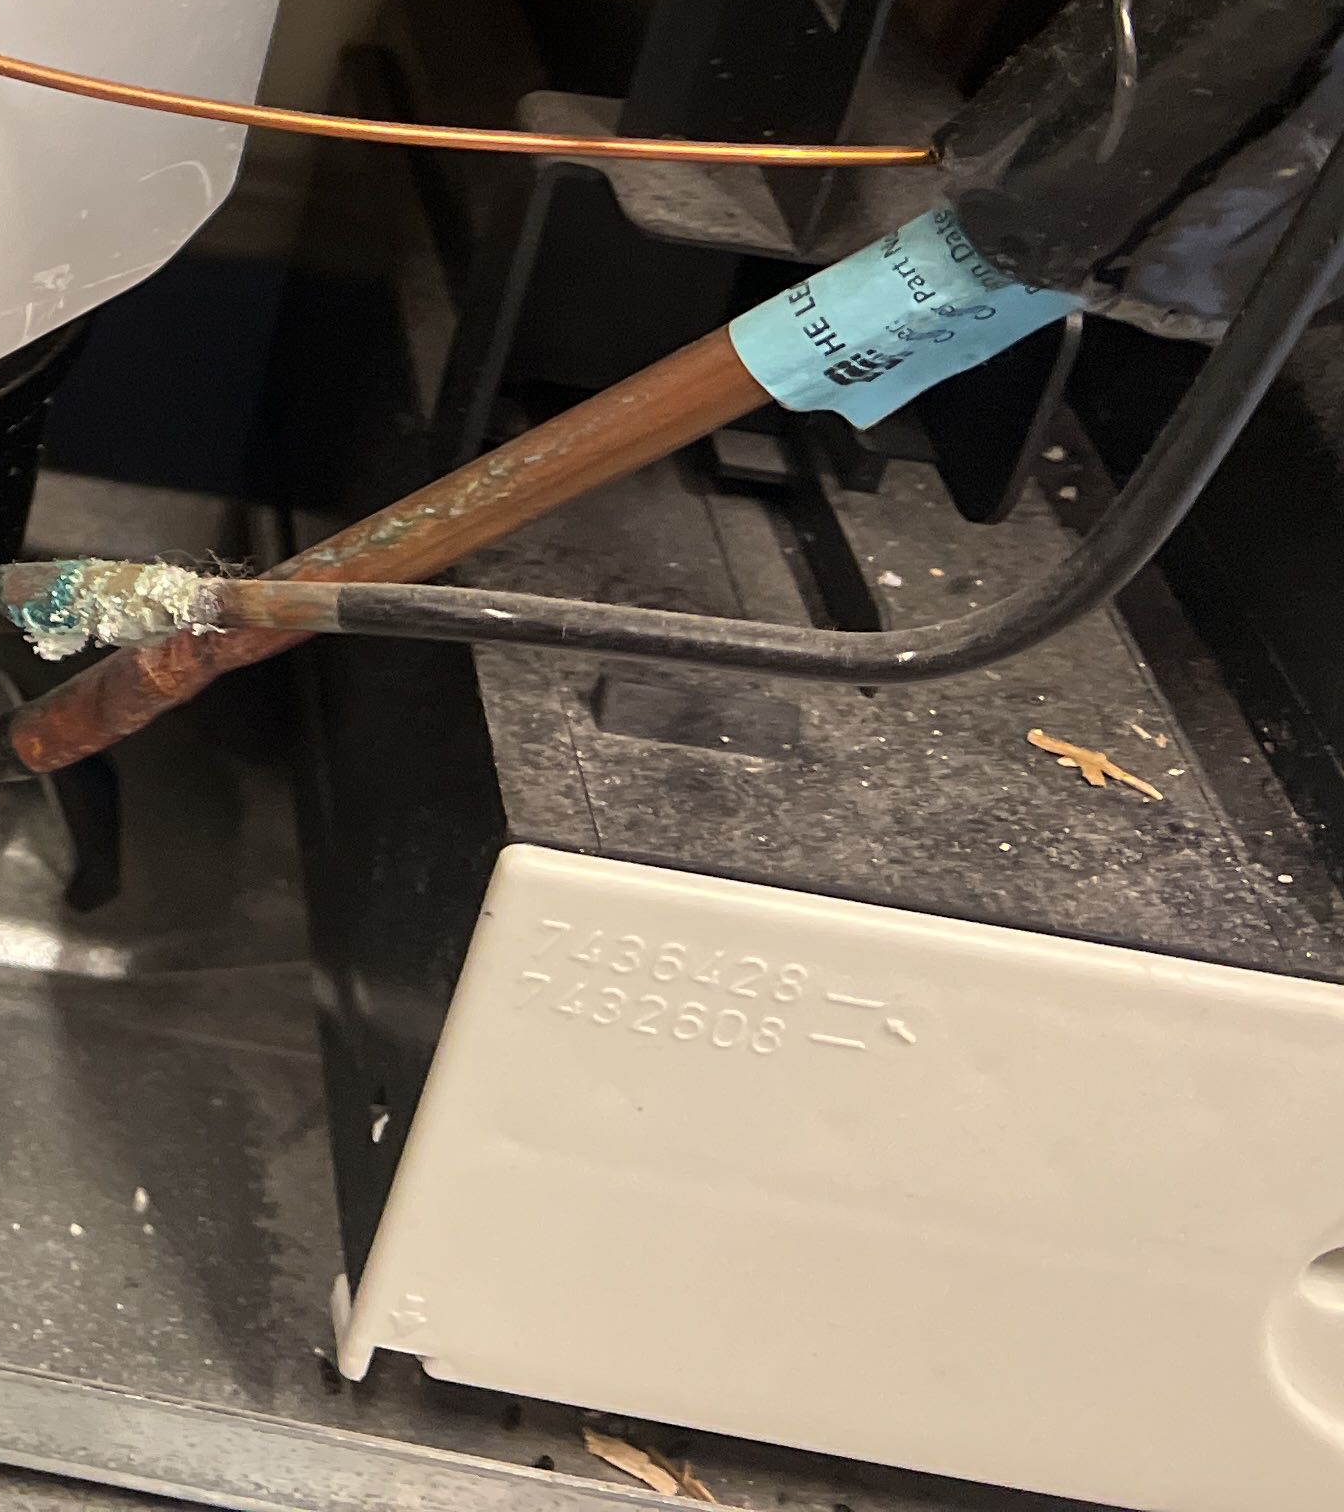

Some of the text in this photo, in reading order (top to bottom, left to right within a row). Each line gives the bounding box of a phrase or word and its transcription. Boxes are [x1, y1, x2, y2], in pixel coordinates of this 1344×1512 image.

[891, 256, 936, 303] Part
[532, 918, 809, 1003] 7436428
[515, 970, 787, 1055] 7432608
